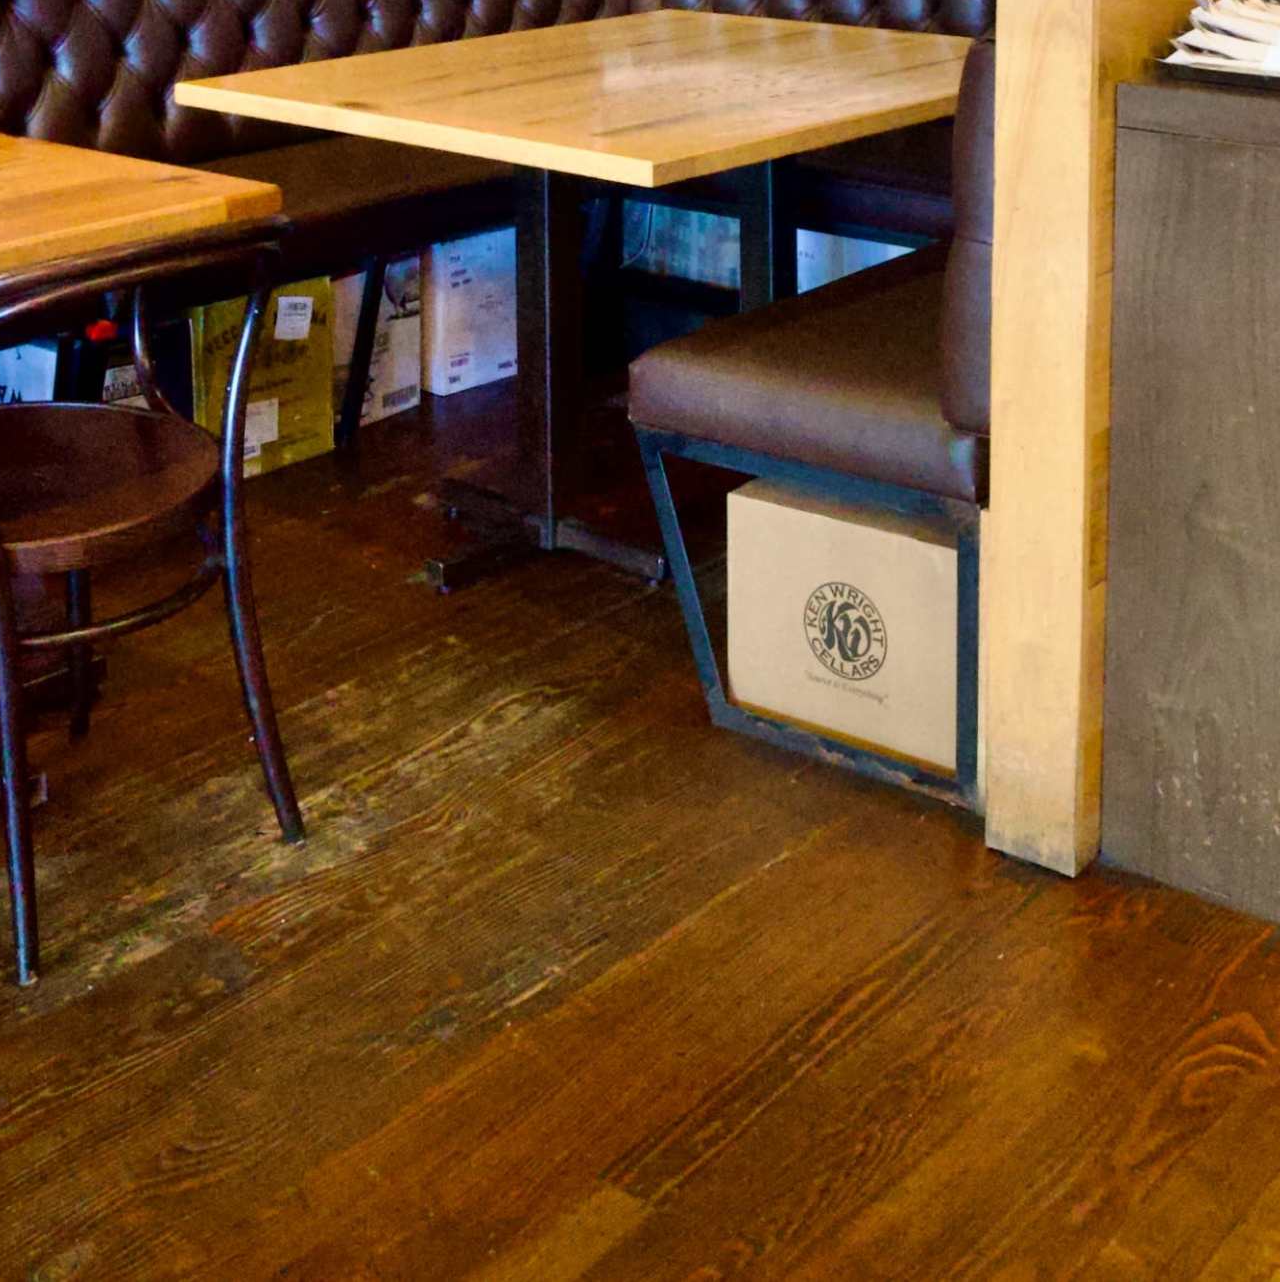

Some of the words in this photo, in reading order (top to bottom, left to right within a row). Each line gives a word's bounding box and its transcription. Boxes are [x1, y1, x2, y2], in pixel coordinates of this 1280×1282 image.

[805, 591, 830, 629] KEN
[830, 584, 886, 647] WRIGHT
[809, 636, 881, 679] CELLARS
